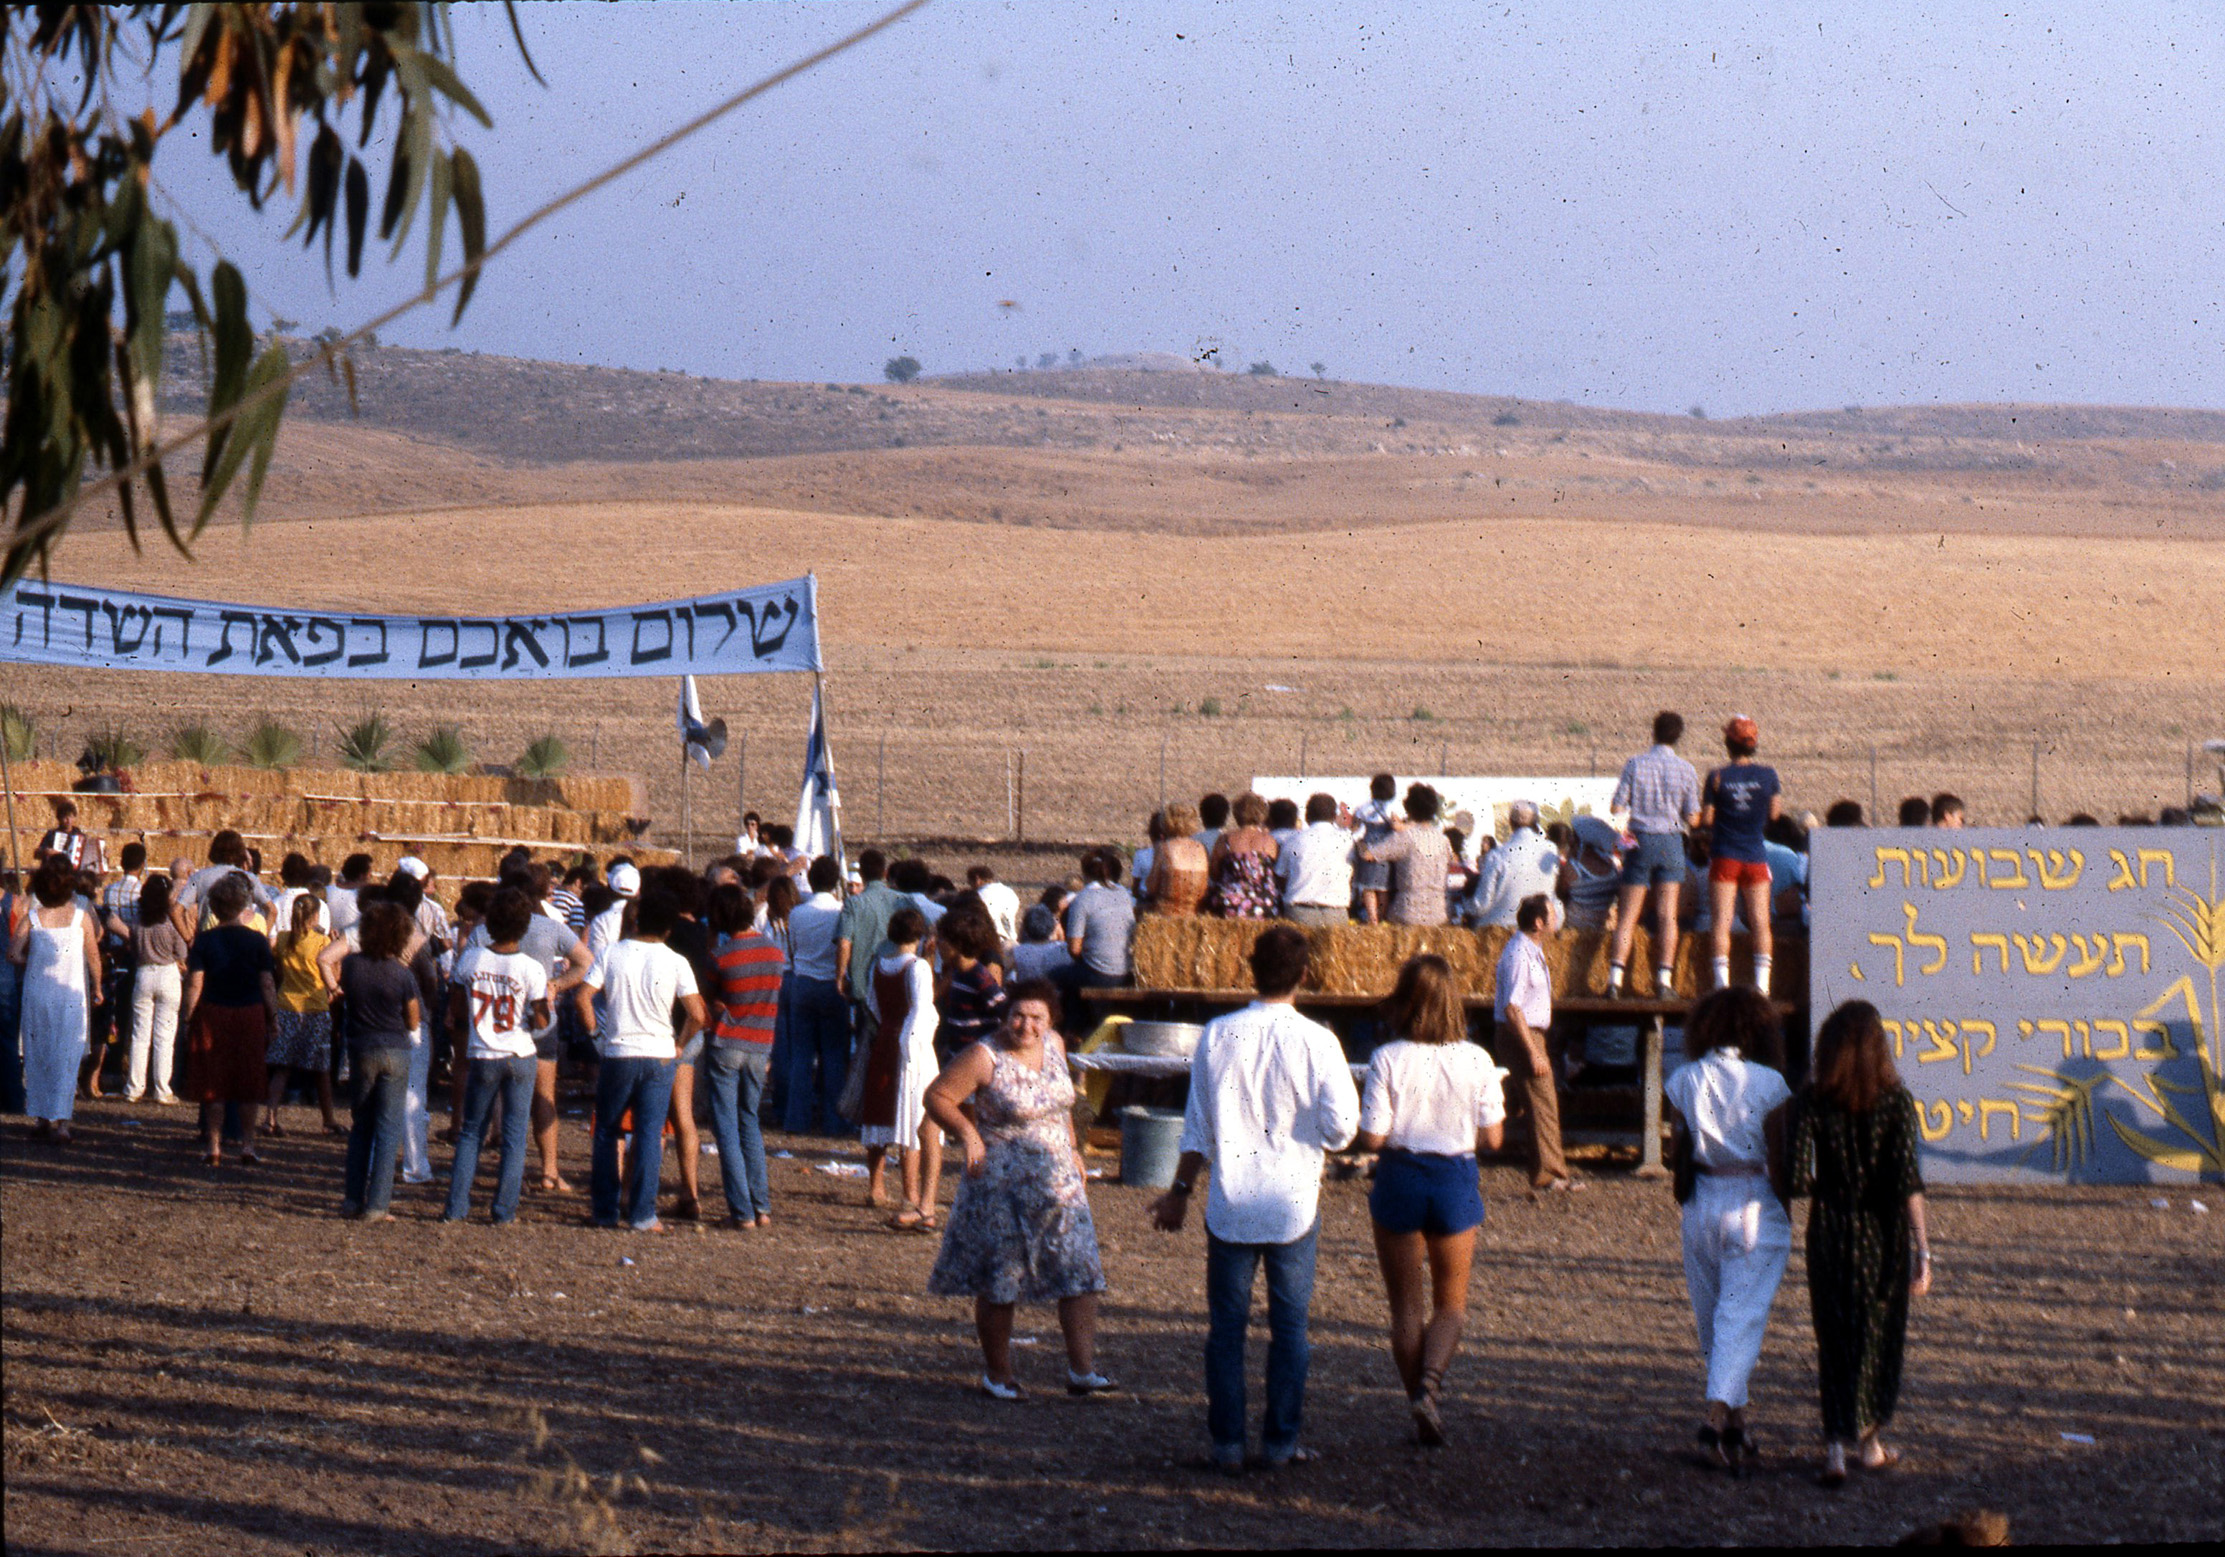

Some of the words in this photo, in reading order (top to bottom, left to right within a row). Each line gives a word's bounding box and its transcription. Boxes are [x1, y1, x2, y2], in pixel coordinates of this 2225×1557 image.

[13, 590, 195, 658] השדה
[206, 610, 390, 668] בפאת
[417, 616, 610, 671] בואכם
[1867, 846, 2086, 891] שבועות
[2106, 846, 2175, 893] חג
[1970, 931, 2152, 978] תעשה
[470, 989, 516, 1034] 79
[1881, 1017, 1997, 1076] קציר
[2017, 1017, 2180, 1062] בכורי
[1914, 1096, 2021, 1142] חיט
